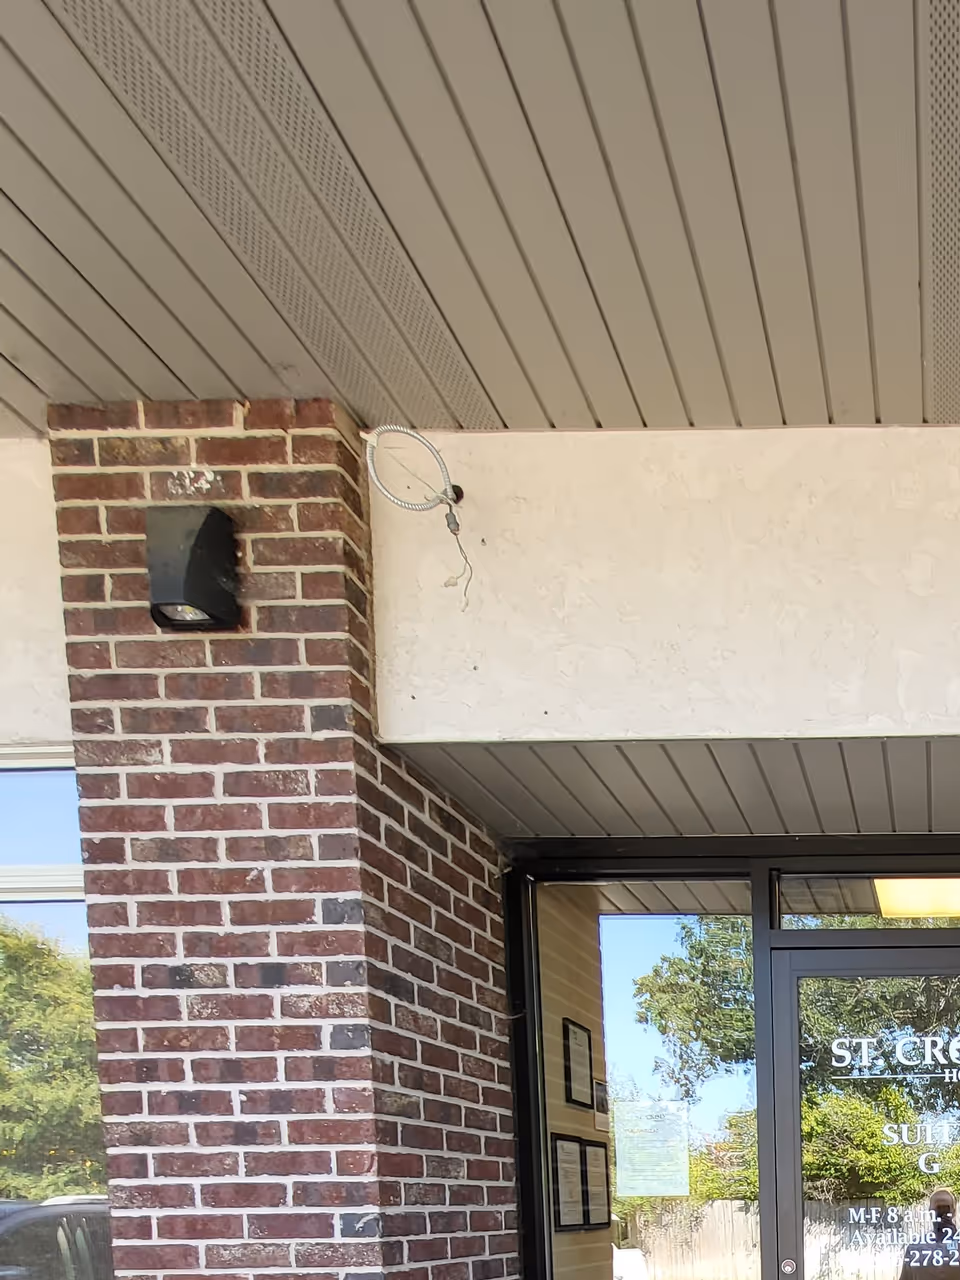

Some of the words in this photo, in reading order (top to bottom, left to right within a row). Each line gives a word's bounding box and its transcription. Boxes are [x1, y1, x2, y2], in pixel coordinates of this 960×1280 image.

[831, 1036, 884, 1067] ST.
[918, 1152, 941, 1174] G
[848, 1207, 882, 1224] M-F
[887, 1206, 899, 1223] 8
[849, 1227, 937, 1246] Available
